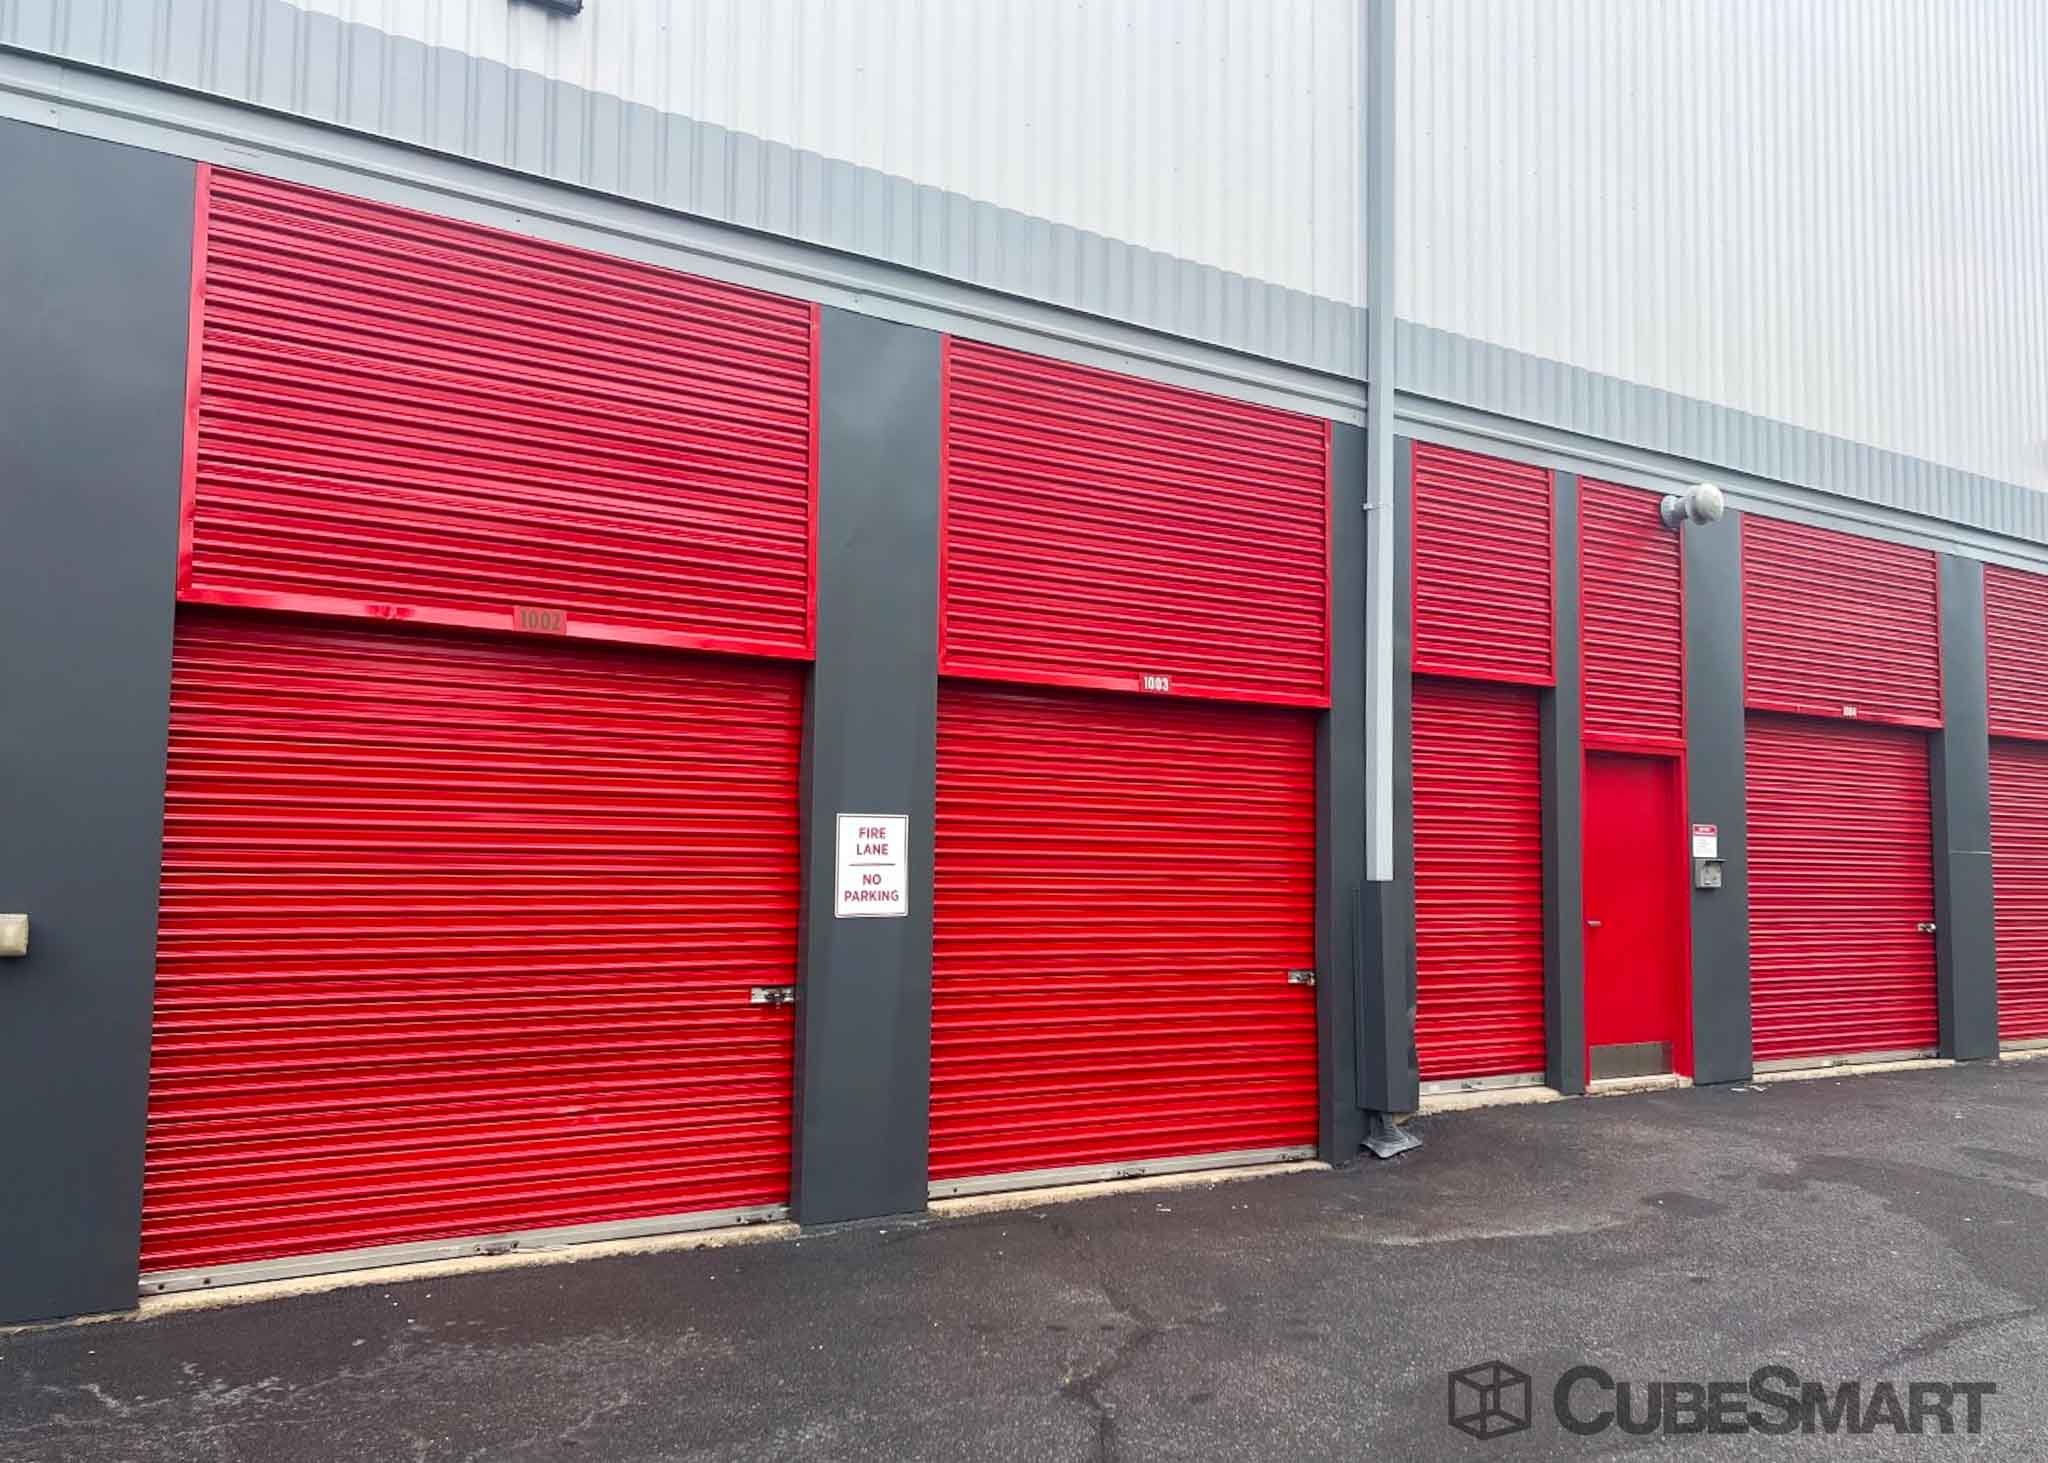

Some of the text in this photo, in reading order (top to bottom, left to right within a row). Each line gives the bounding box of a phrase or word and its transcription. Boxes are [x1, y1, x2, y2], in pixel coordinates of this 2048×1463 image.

[520, 608, 561, 631] 1002
[1144, 676, 1168, 691] 1003
[859, 827, 886, 839] FIRE
[857, 843, 888, 855] LANE
[863, 873, 881, 885] NO
[844, 890, 899, 902] PARKING
